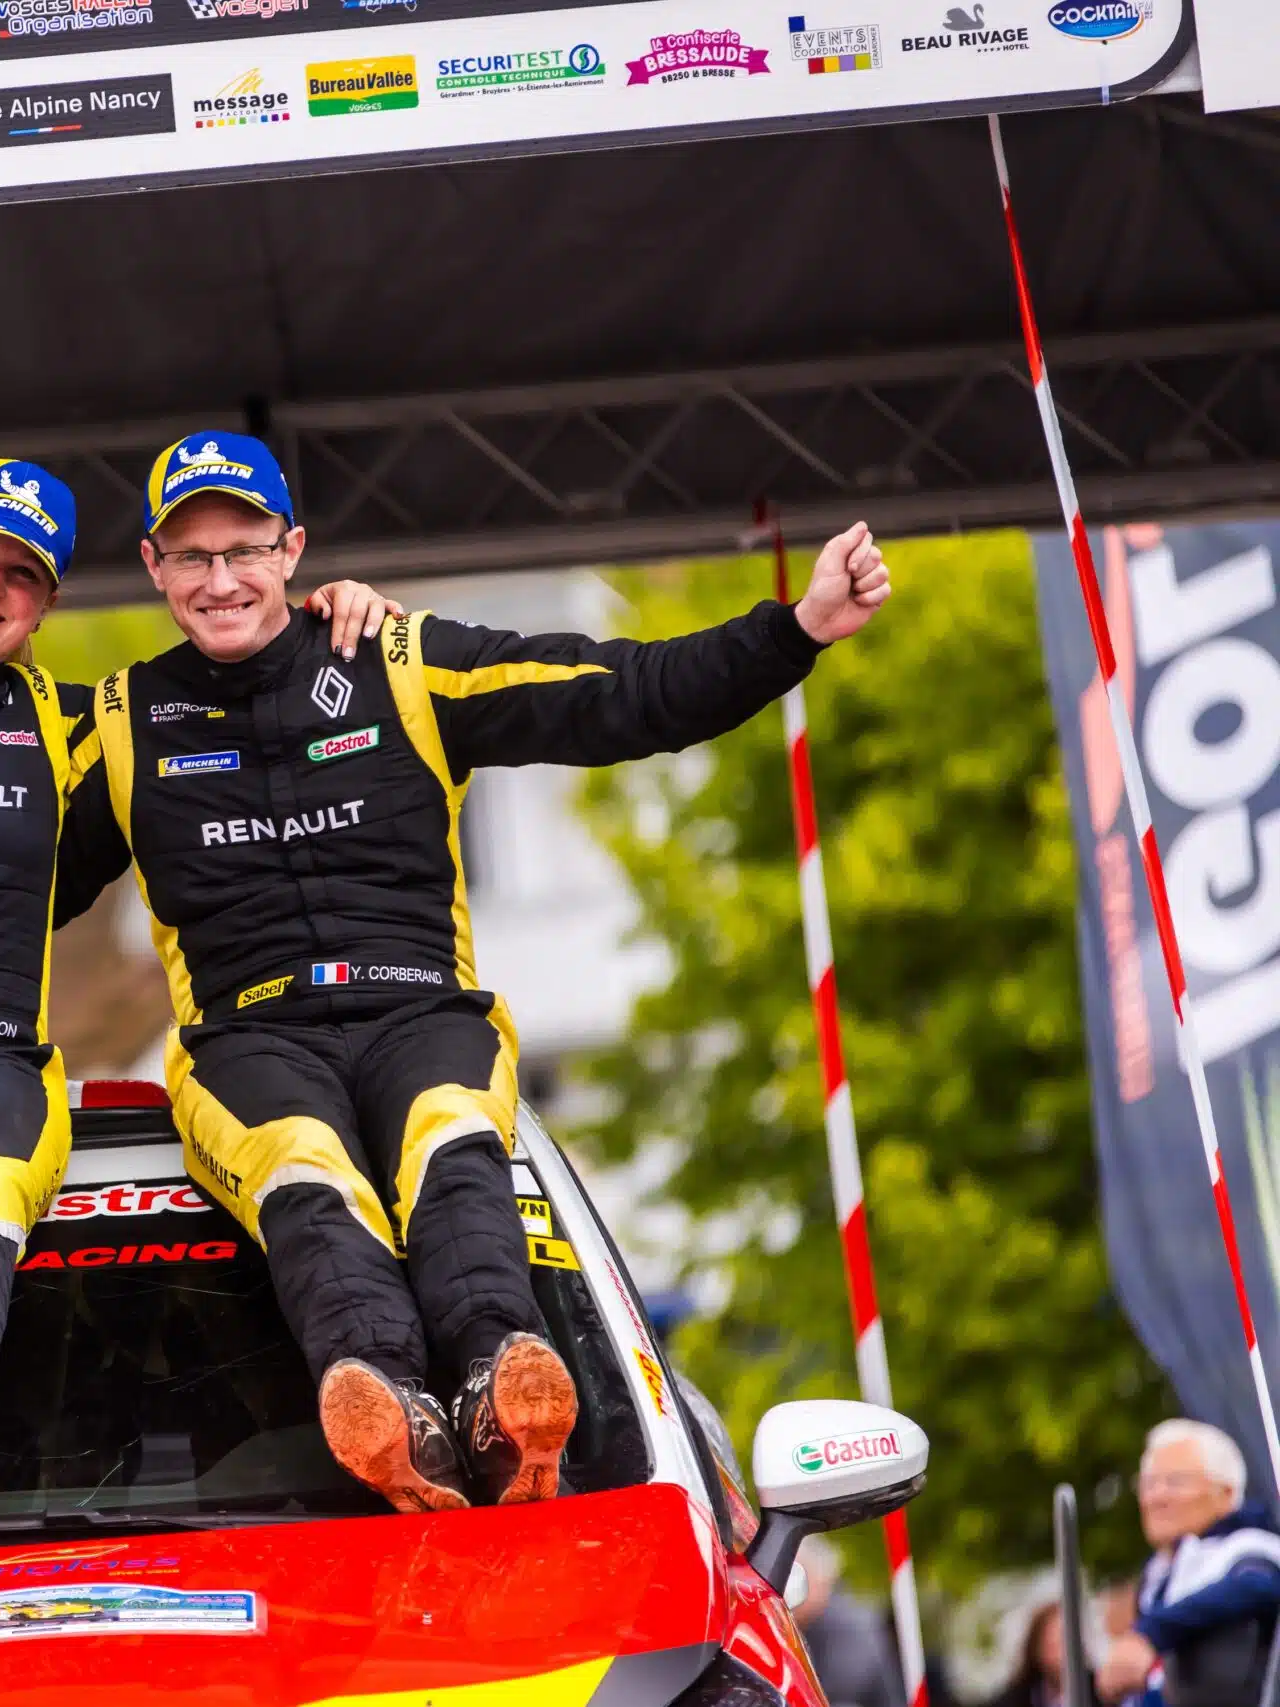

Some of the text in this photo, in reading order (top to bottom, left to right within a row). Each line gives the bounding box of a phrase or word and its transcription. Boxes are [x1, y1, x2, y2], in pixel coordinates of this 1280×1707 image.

[8, 8, 153, 35] Organisation
[667, 29, 740, 48] Confiserie
[792, 28, 867, 50] EVENTS
[901, 27, 1029, 51] BEAU RIVAGE
[438, 50, 563, 76] SECURITEST
[645, 47, 751, 72] BRESSAUDE
[793, 44, 868, 58] COORDINATION
[439, 69, 566, 88] CONTROLE TECHNIQUE
[662, 71, 690, 84] 88250
[702, 69, 736, 78] BRESSE
[194, 92, 288, 112] message
[440, 89, 475, 99] Gérardmer
[482, 87, 511, 96] Bruyères
[10, 97, 82, 122] Alpine
[90, 89, 161, 110] Nancy
[220, 108, 264, 117] FACTORY
[349, 102, 382, 113] VOSGES
[165, 465, 252, 494] MICHELIN
[388, 613, 411, 665] Sabe
[104, 673, 124, 714] abelt
[150, 703, 222, 715] CLIOTROPH
[0, 731, 38, 745] Castrol
[324, 731, 371, 757] Castrol
[182, 758, 232, 769] MICHELIN
[201, 800, 365, 846] RENAULT
[242, 966, 443, 1004] Sabelt Y. CORBERAND
[45, 1186, 208, 1217] stro
[16, 1241, 238, 1271] ACING
[823, 1432, 900, 1466] Castrol
